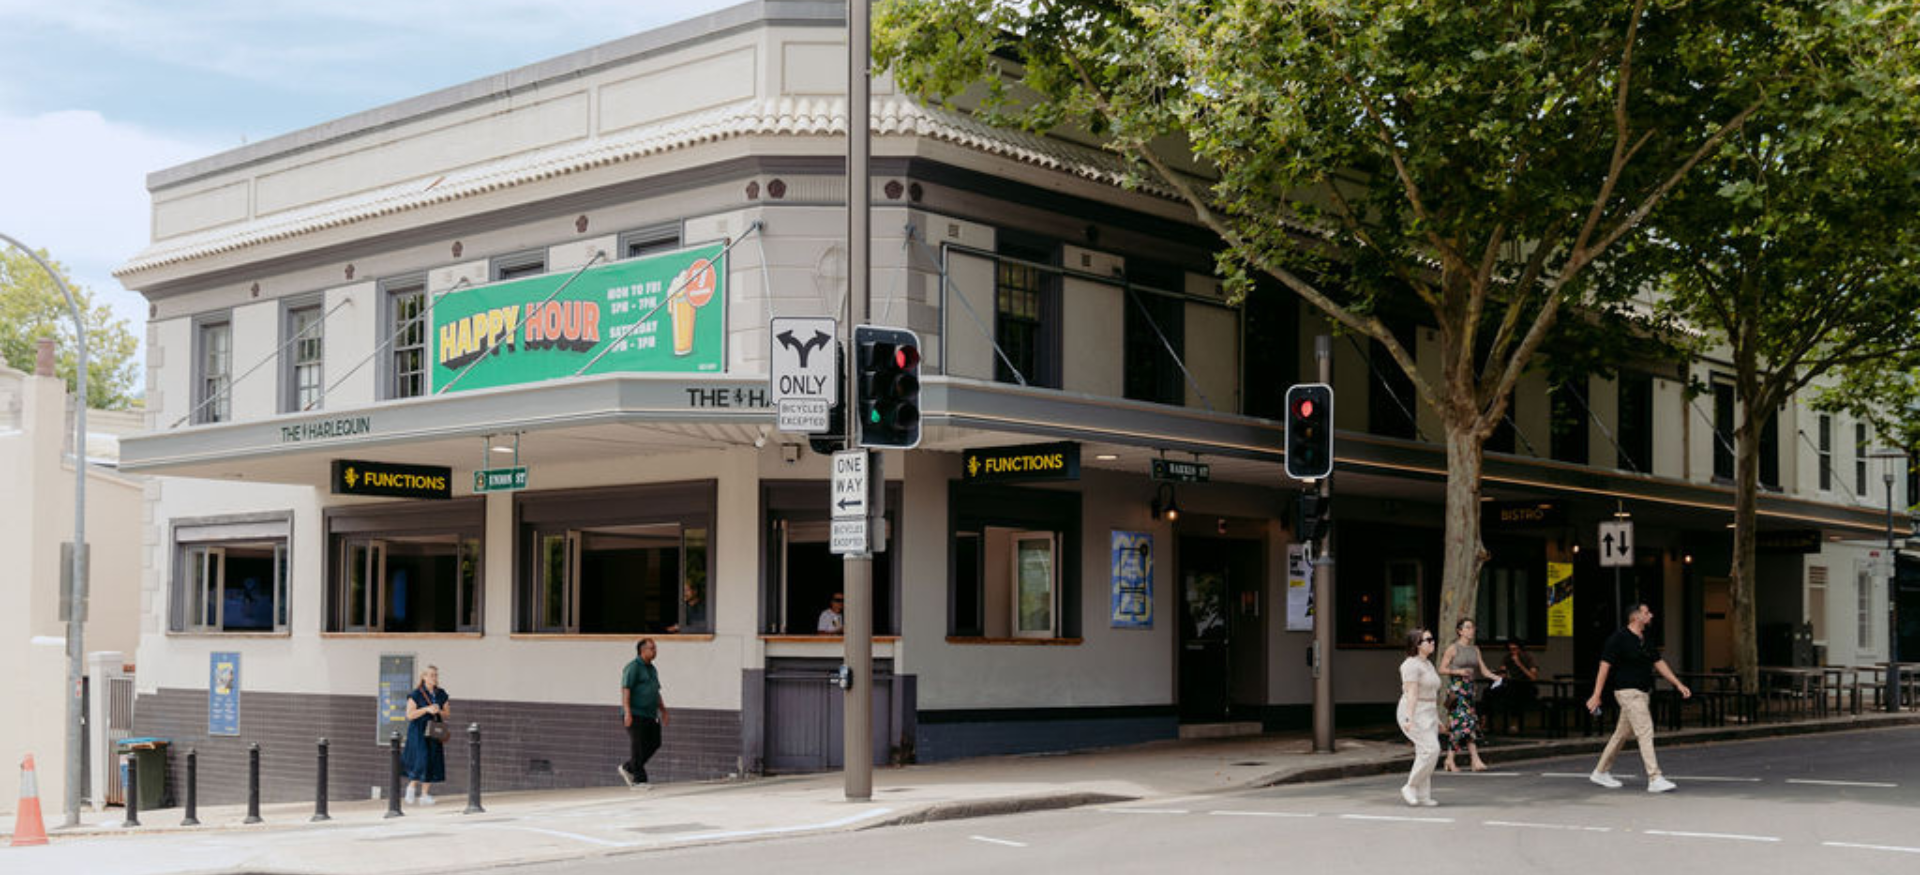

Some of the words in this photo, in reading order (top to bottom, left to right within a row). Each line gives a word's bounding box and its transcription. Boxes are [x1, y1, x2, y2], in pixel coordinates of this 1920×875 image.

[631, 283, 643, 296] TO
[646, 280, 662, 294] FRI
[440, 304, 520, 364] HAPPY
[525, 300, 600, 342] HOUR
[780, 375, 827, 395] ONLY
[686, 388, 730, 407] THE
[781, 404, 825, 413] BICYCLES
[281, 427, 301, 442] THE
[308, 416, 371, 440] HARLEQUIN
[781, 416, 825, 427] EXCEPTED
[837, 458, 862, 473] ONE
[985, 453, 1064, 473] FUNCTIONS
[363, 471, 446, 491] FUNCTIONS
[836, 478, 863, 493] WAY
[1501, 508, 1544, 521] BISTRO
